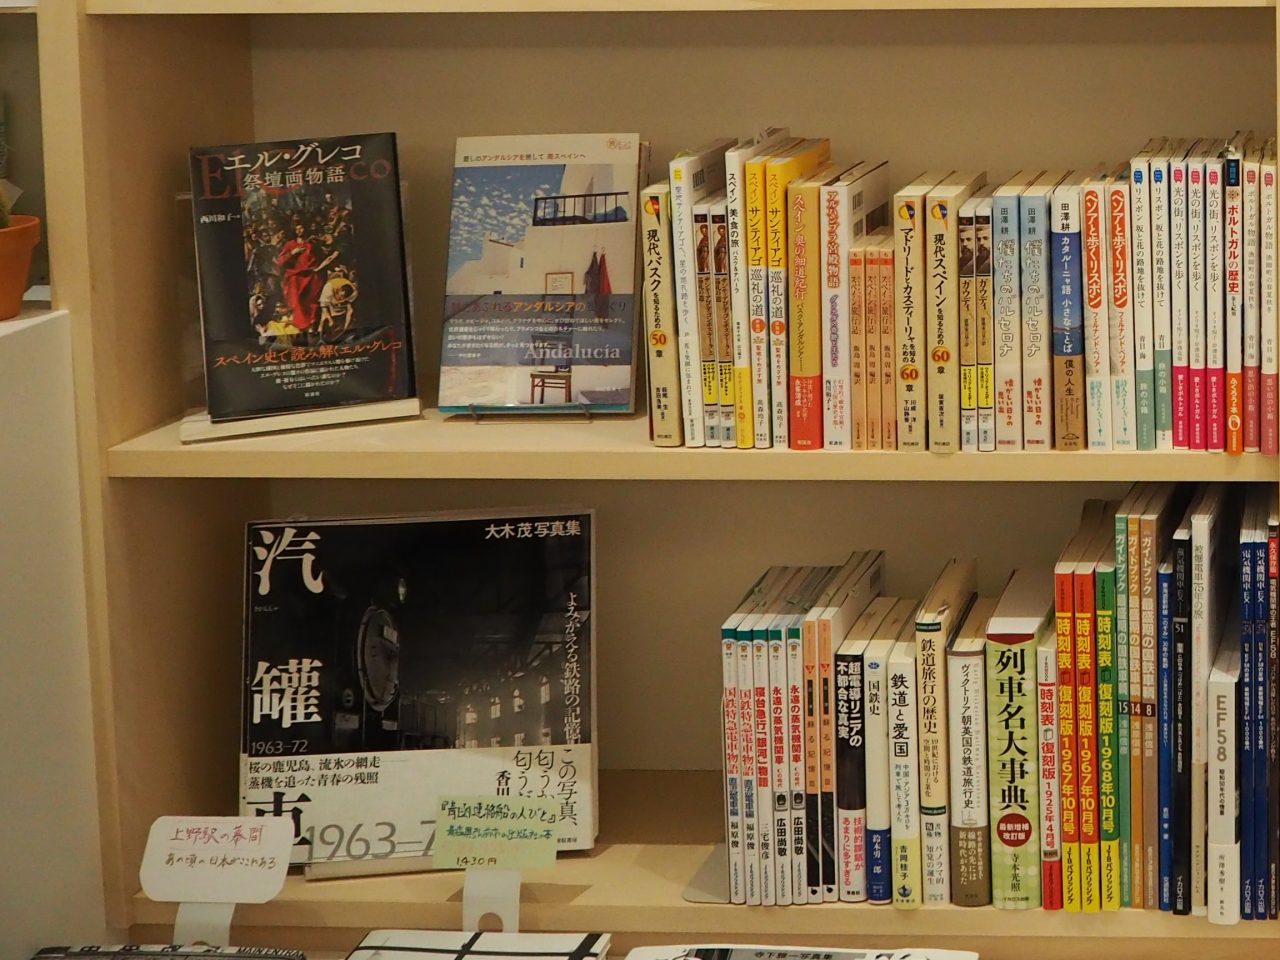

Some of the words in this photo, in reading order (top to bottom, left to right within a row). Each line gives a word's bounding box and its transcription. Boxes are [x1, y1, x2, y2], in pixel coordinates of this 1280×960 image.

[223, 142, 361, 171] エル・グレコ
[243, 165, 346, 191] 祭壇画物語
[728, 173, 737, 205] スペイン
[749, 172, 758, 207] スペイン
[1135, 187, 1144, 221] リスボン
[730, 208, 739, 249] 美・食の旅
[748, 208, 761, 267] サンティアゴ
[1061, 236, 1072, 296] カタルーニャ語
[1135, 224, 1145, 308] 坂と花の路地を抜けて
[1227, 205, 1240, 293] ポルトガルの歴史
[513, 301, 586, 313] アンダルシアの
[751, 268, 764, 318] 巡礼の道
[961, 278, 971, 312] ガウディ
[997, 238, 1016, 358] 僕たちのバルセロナ
[1062, 299, 1073, 354] 小さなことば
[213, 341, 402, 368] スペイン史で読み解くエル・グレコ
[1064, 359, 1074, 396] 僕の人生
[836, 661, 849, 739] 不都合な真実
[848, 661, 862, 747] 超電導リニアの
[868, 680, 880, 716] 国鉄史
[921, 639, 938, 734] 鉄道旅行の歴史
[891, 674, 909, 758] 鉄道と愛国
[995, 648, 1029, 812] 列車名大事典
[1216, 694, 1227, 763] EF58
[250, 739, 308, 754] 1963-72
[961, 664, 975, 810] ヴィクトリア朝英国の鉄道旅行史
[248, 756, 381, 774] 桜の鹿児島、流氷の網走
[248, 772, 379, 790] 蒸機を追った青春の残照
[169, 825, 264, 846] 上野駅の幕間
[776, 818, 787, 857] 広田尚敬
